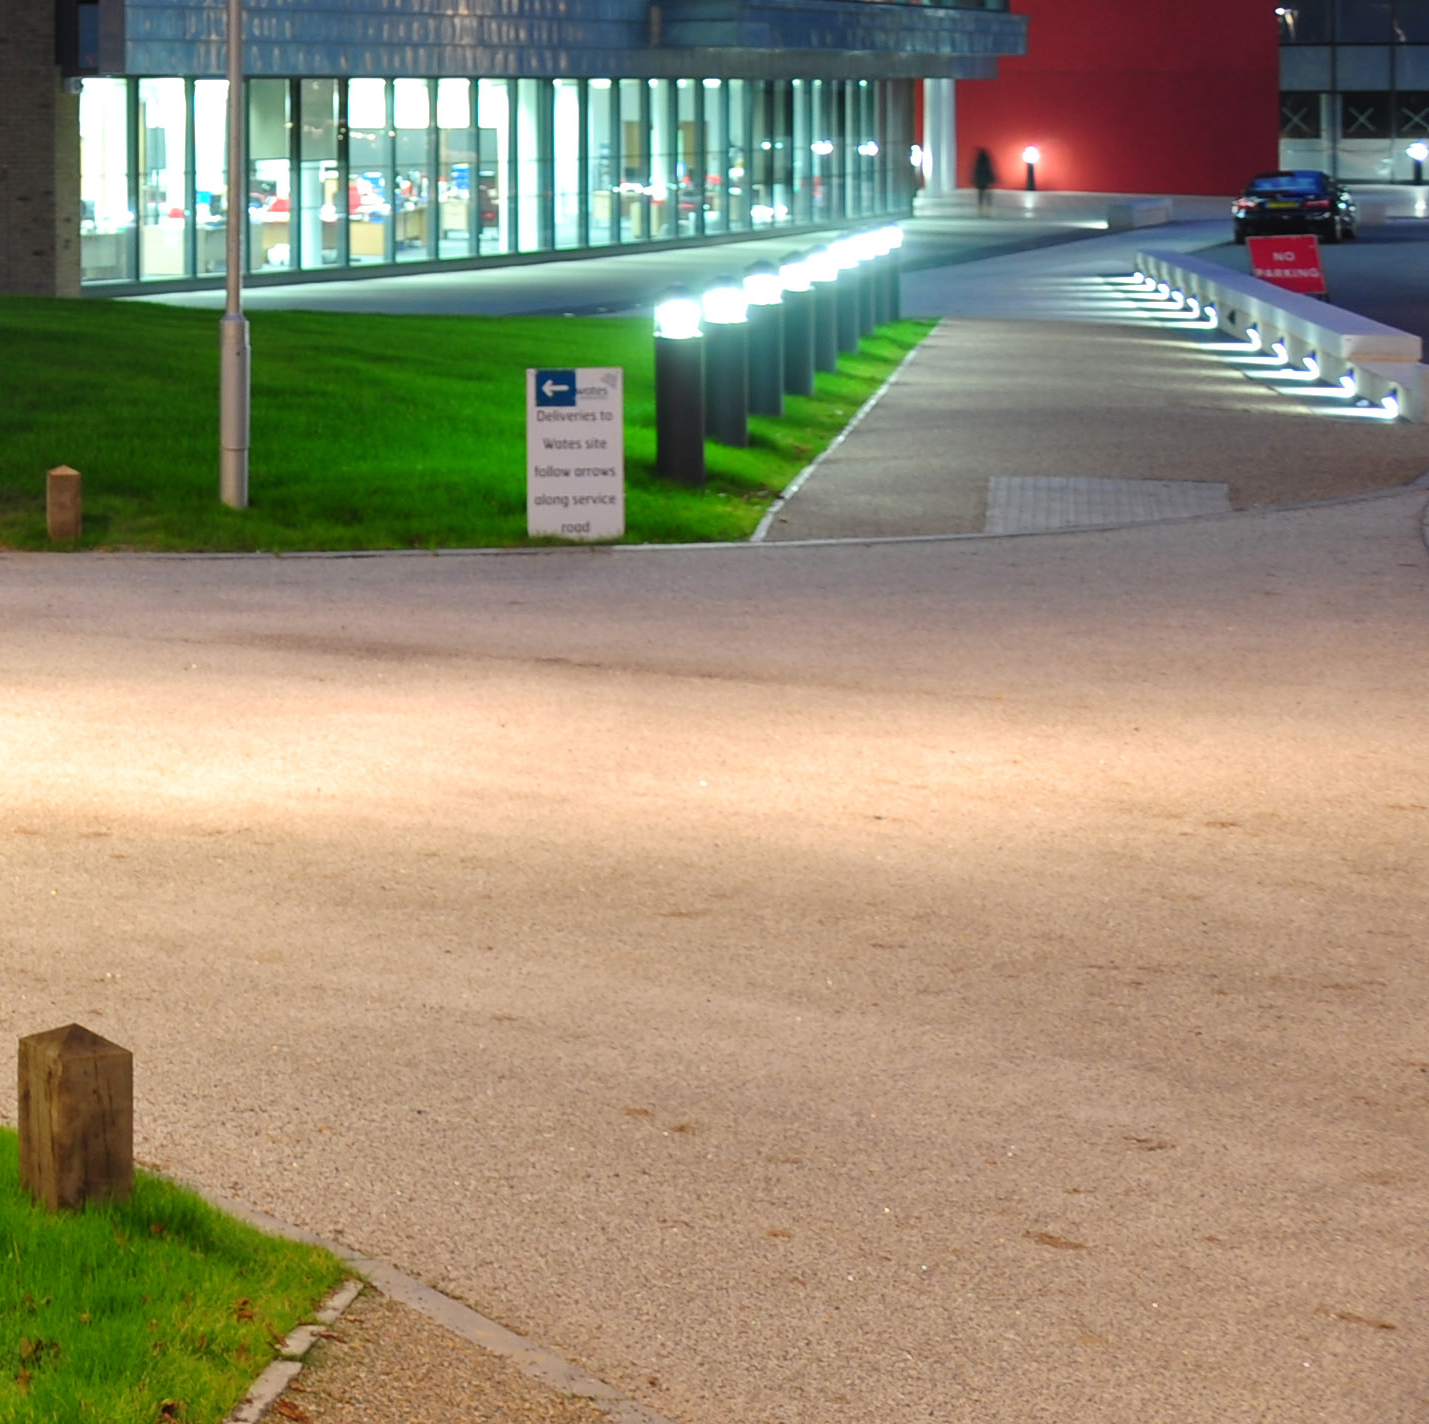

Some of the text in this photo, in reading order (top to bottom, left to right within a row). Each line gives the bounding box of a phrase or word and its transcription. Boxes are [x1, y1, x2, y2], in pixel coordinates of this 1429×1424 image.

[1272, 251, 1296, 262] NO
[1255, 267, 1321, 278] PARKING
[536, 410, 614, 423] Deliveries to
[543, 437, 608, 450] Wates site
[535, 465, 616, 478] follow arrows
[534, 493, 617, 509] along service
[561, 521, 591, 534] road
